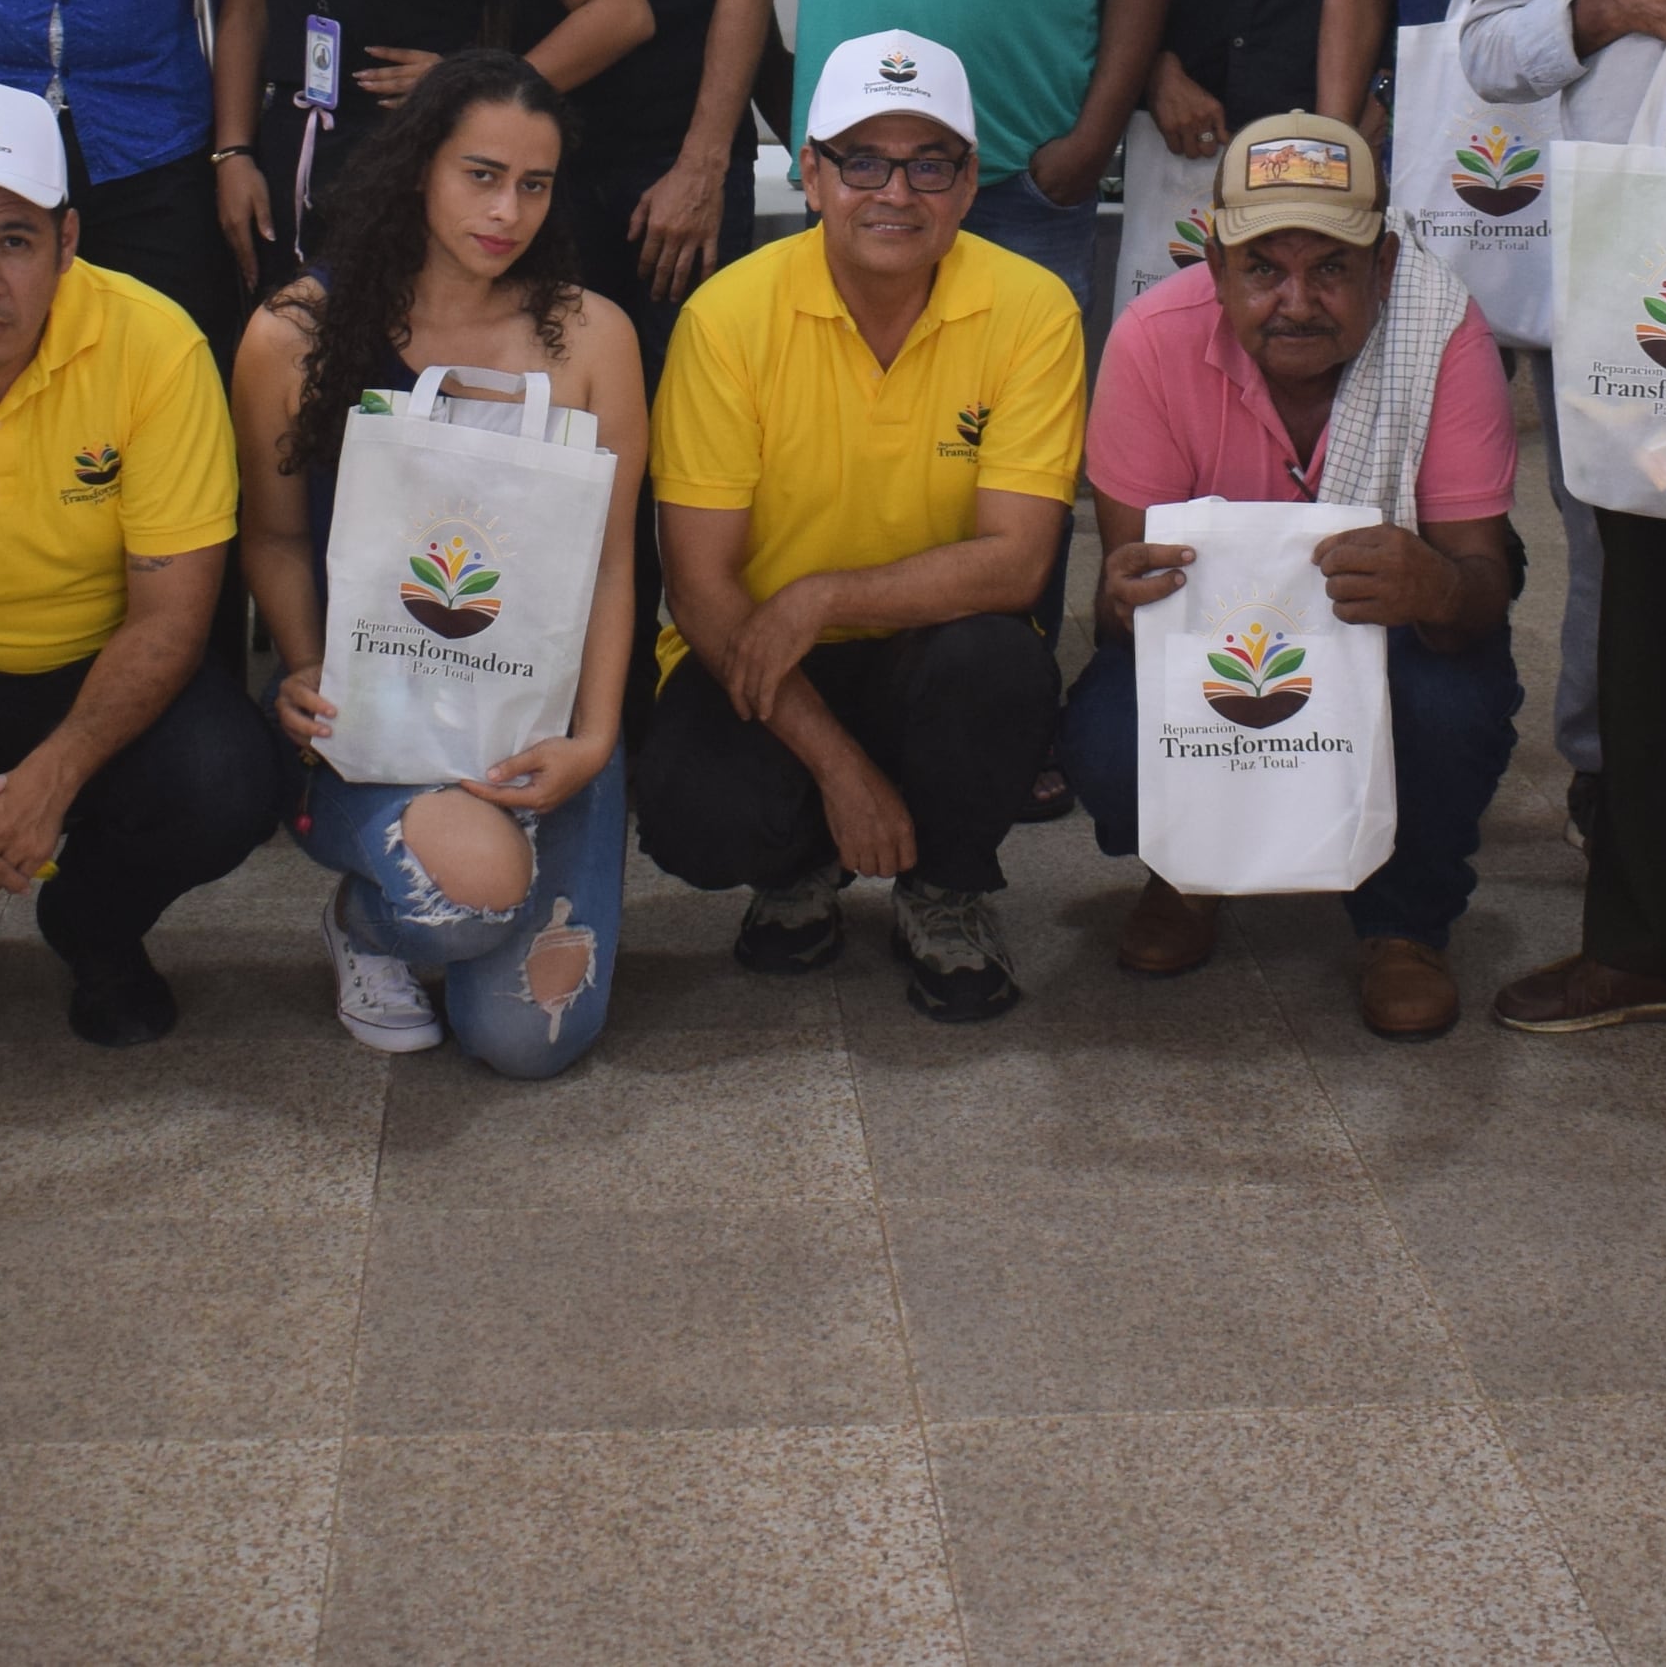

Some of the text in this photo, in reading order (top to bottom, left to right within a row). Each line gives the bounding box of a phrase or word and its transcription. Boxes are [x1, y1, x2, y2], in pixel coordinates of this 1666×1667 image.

[1417, 220, 1551, 237] Transformad
[1469, 239, 1529, 251] Paz Total
[351, 632, 534, 677] Transformadora
[412, 660, 475, 683] Paz Total
[1163, 723, 1237, 738] Reparación
[1160, 732, 1353, 759] Transformadora
